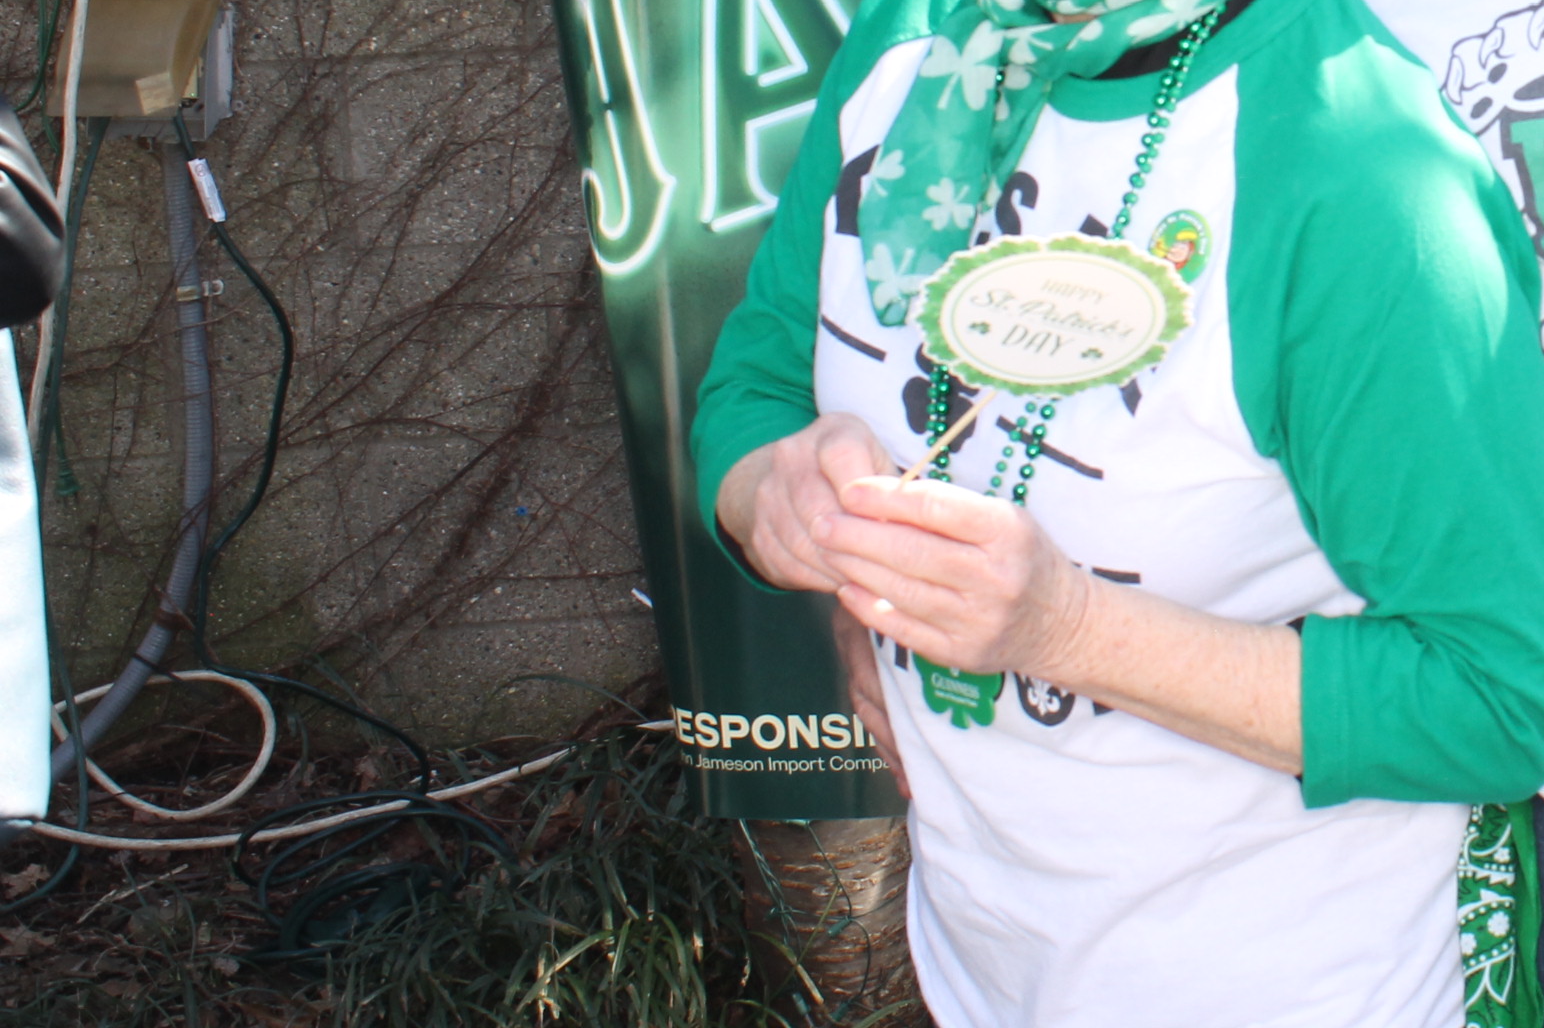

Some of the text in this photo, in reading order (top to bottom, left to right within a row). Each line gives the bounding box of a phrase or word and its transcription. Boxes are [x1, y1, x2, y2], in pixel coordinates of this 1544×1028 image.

[1001, 324, 1075, 356] DAY
[672, 707, 876, 750] ESPONSI
[696, 754, 764, 771] Jameson
[769, 757, 825, 775] Import
